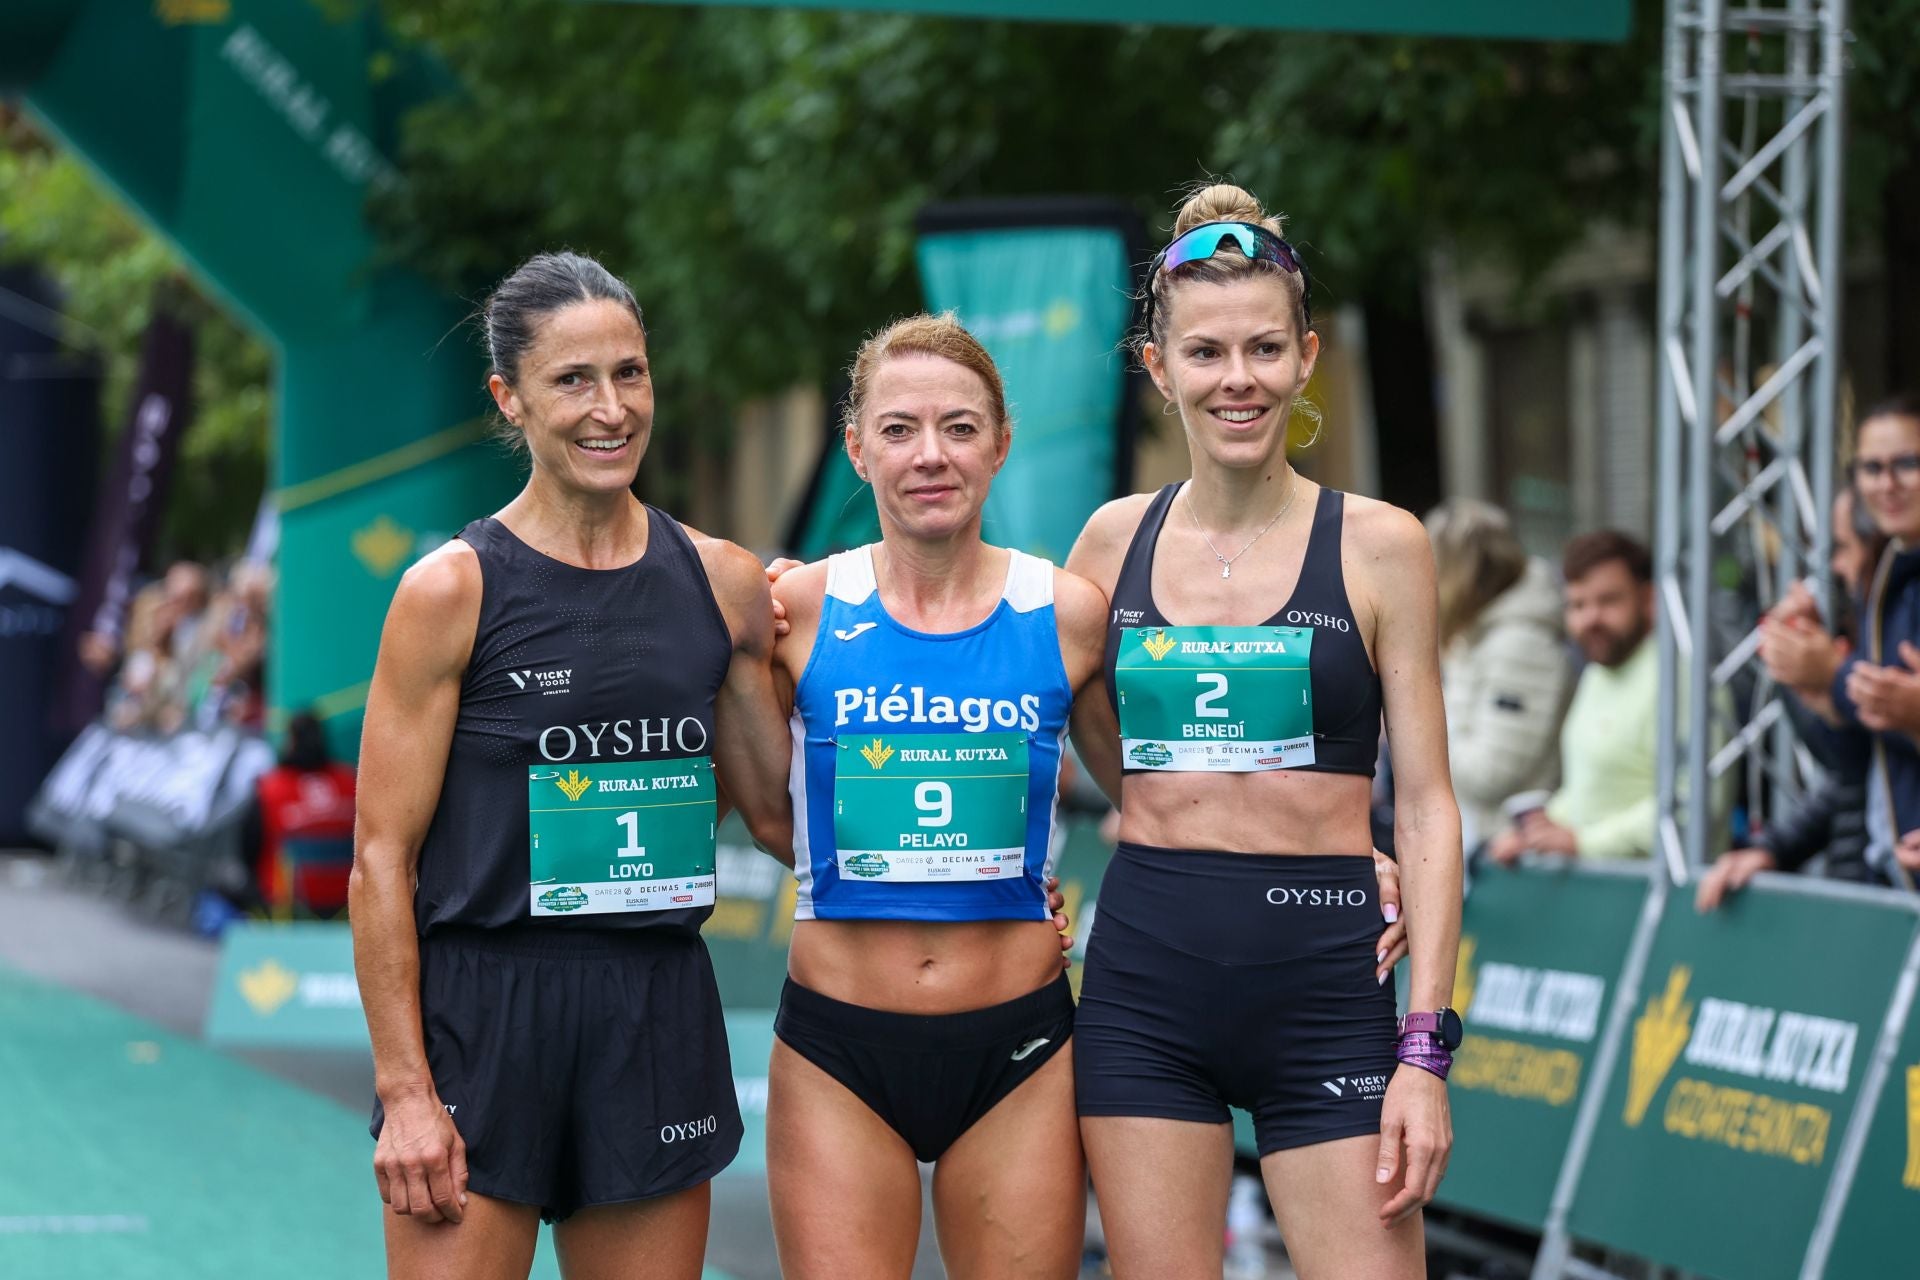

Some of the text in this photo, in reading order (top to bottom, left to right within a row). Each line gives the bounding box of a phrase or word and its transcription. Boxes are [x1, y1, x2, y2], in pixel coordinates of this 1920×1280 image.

[1122, 610, 1144, 618] VICKY
[1286, 610, 1350, 632] OYSHO
[1180, 642, 1286, 654] RURAL KUTXA
[534, 669, 572, 680] VICKY
[540, 678, 570, 688] FOODS
[1194, 672, 1230, 718] 2
[1182, 720, 1245, 738] BENEDÍ
[538, 717, 707, 761] OYSHO
[900, 748, 1008, 762] RURAL KUTXA
[598, 775, 698, 792] RURAL KUTXA
[914, 781, 952, 827] 9
[616, 811, 646, 858] 1
[900, 833, 968, 848] PELAYO
[610, 862, 654, 878] LOYO
[640, 884, 679, 893] DECIMAS
[1266, 887, 1366, 906] OYSHO
[1351, 1075, 1386, 1088] VICKY
[660, 1114, 716, 1144] OYSHO
